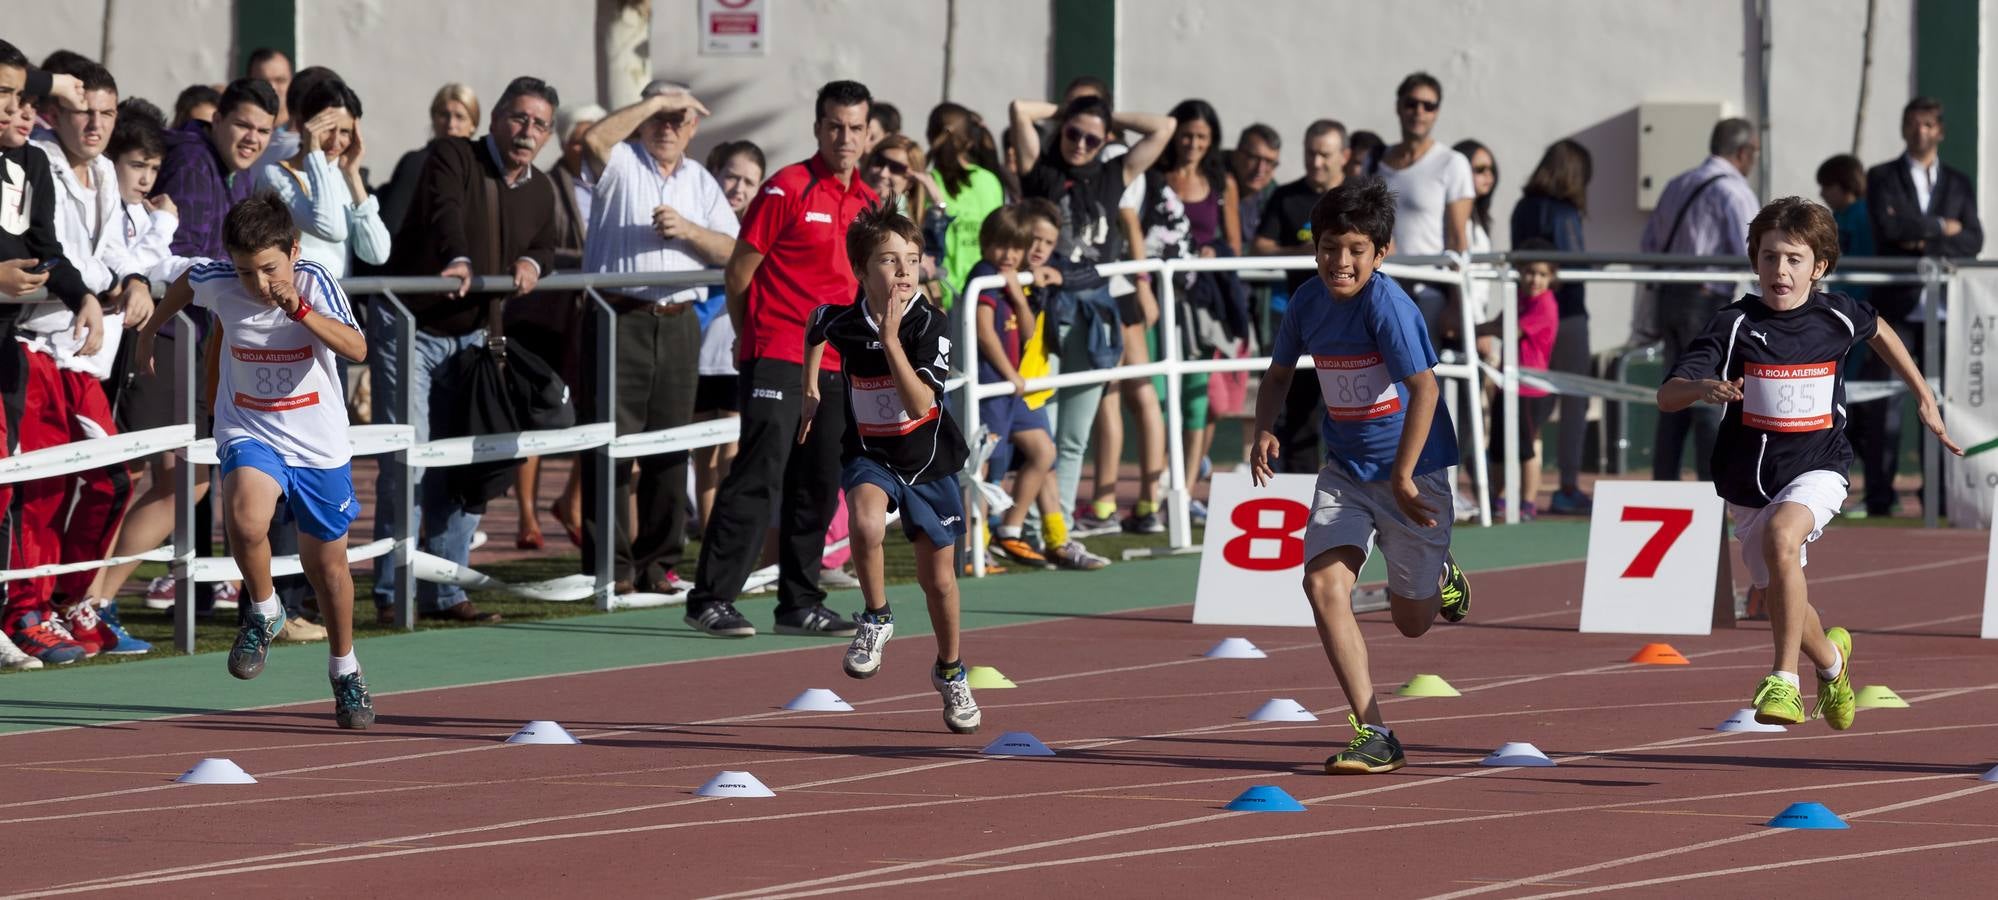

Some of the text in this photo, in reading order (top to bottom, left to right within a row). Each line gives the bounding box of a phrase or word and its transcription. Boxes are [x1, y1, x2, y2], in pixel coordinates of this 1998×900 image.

[255, 366, 295, 395] 88
[1336, 373, 1373, 403] 86
[1753, 367, 1829, 378] LA RIOJA ATLETISMO
[1968, 360, 1985, 407] CLUB
[1776, 383, 1815, 414] 85
[1222, 498, 1312, 572] 8
[1621, 506, 1693, 577] 7
